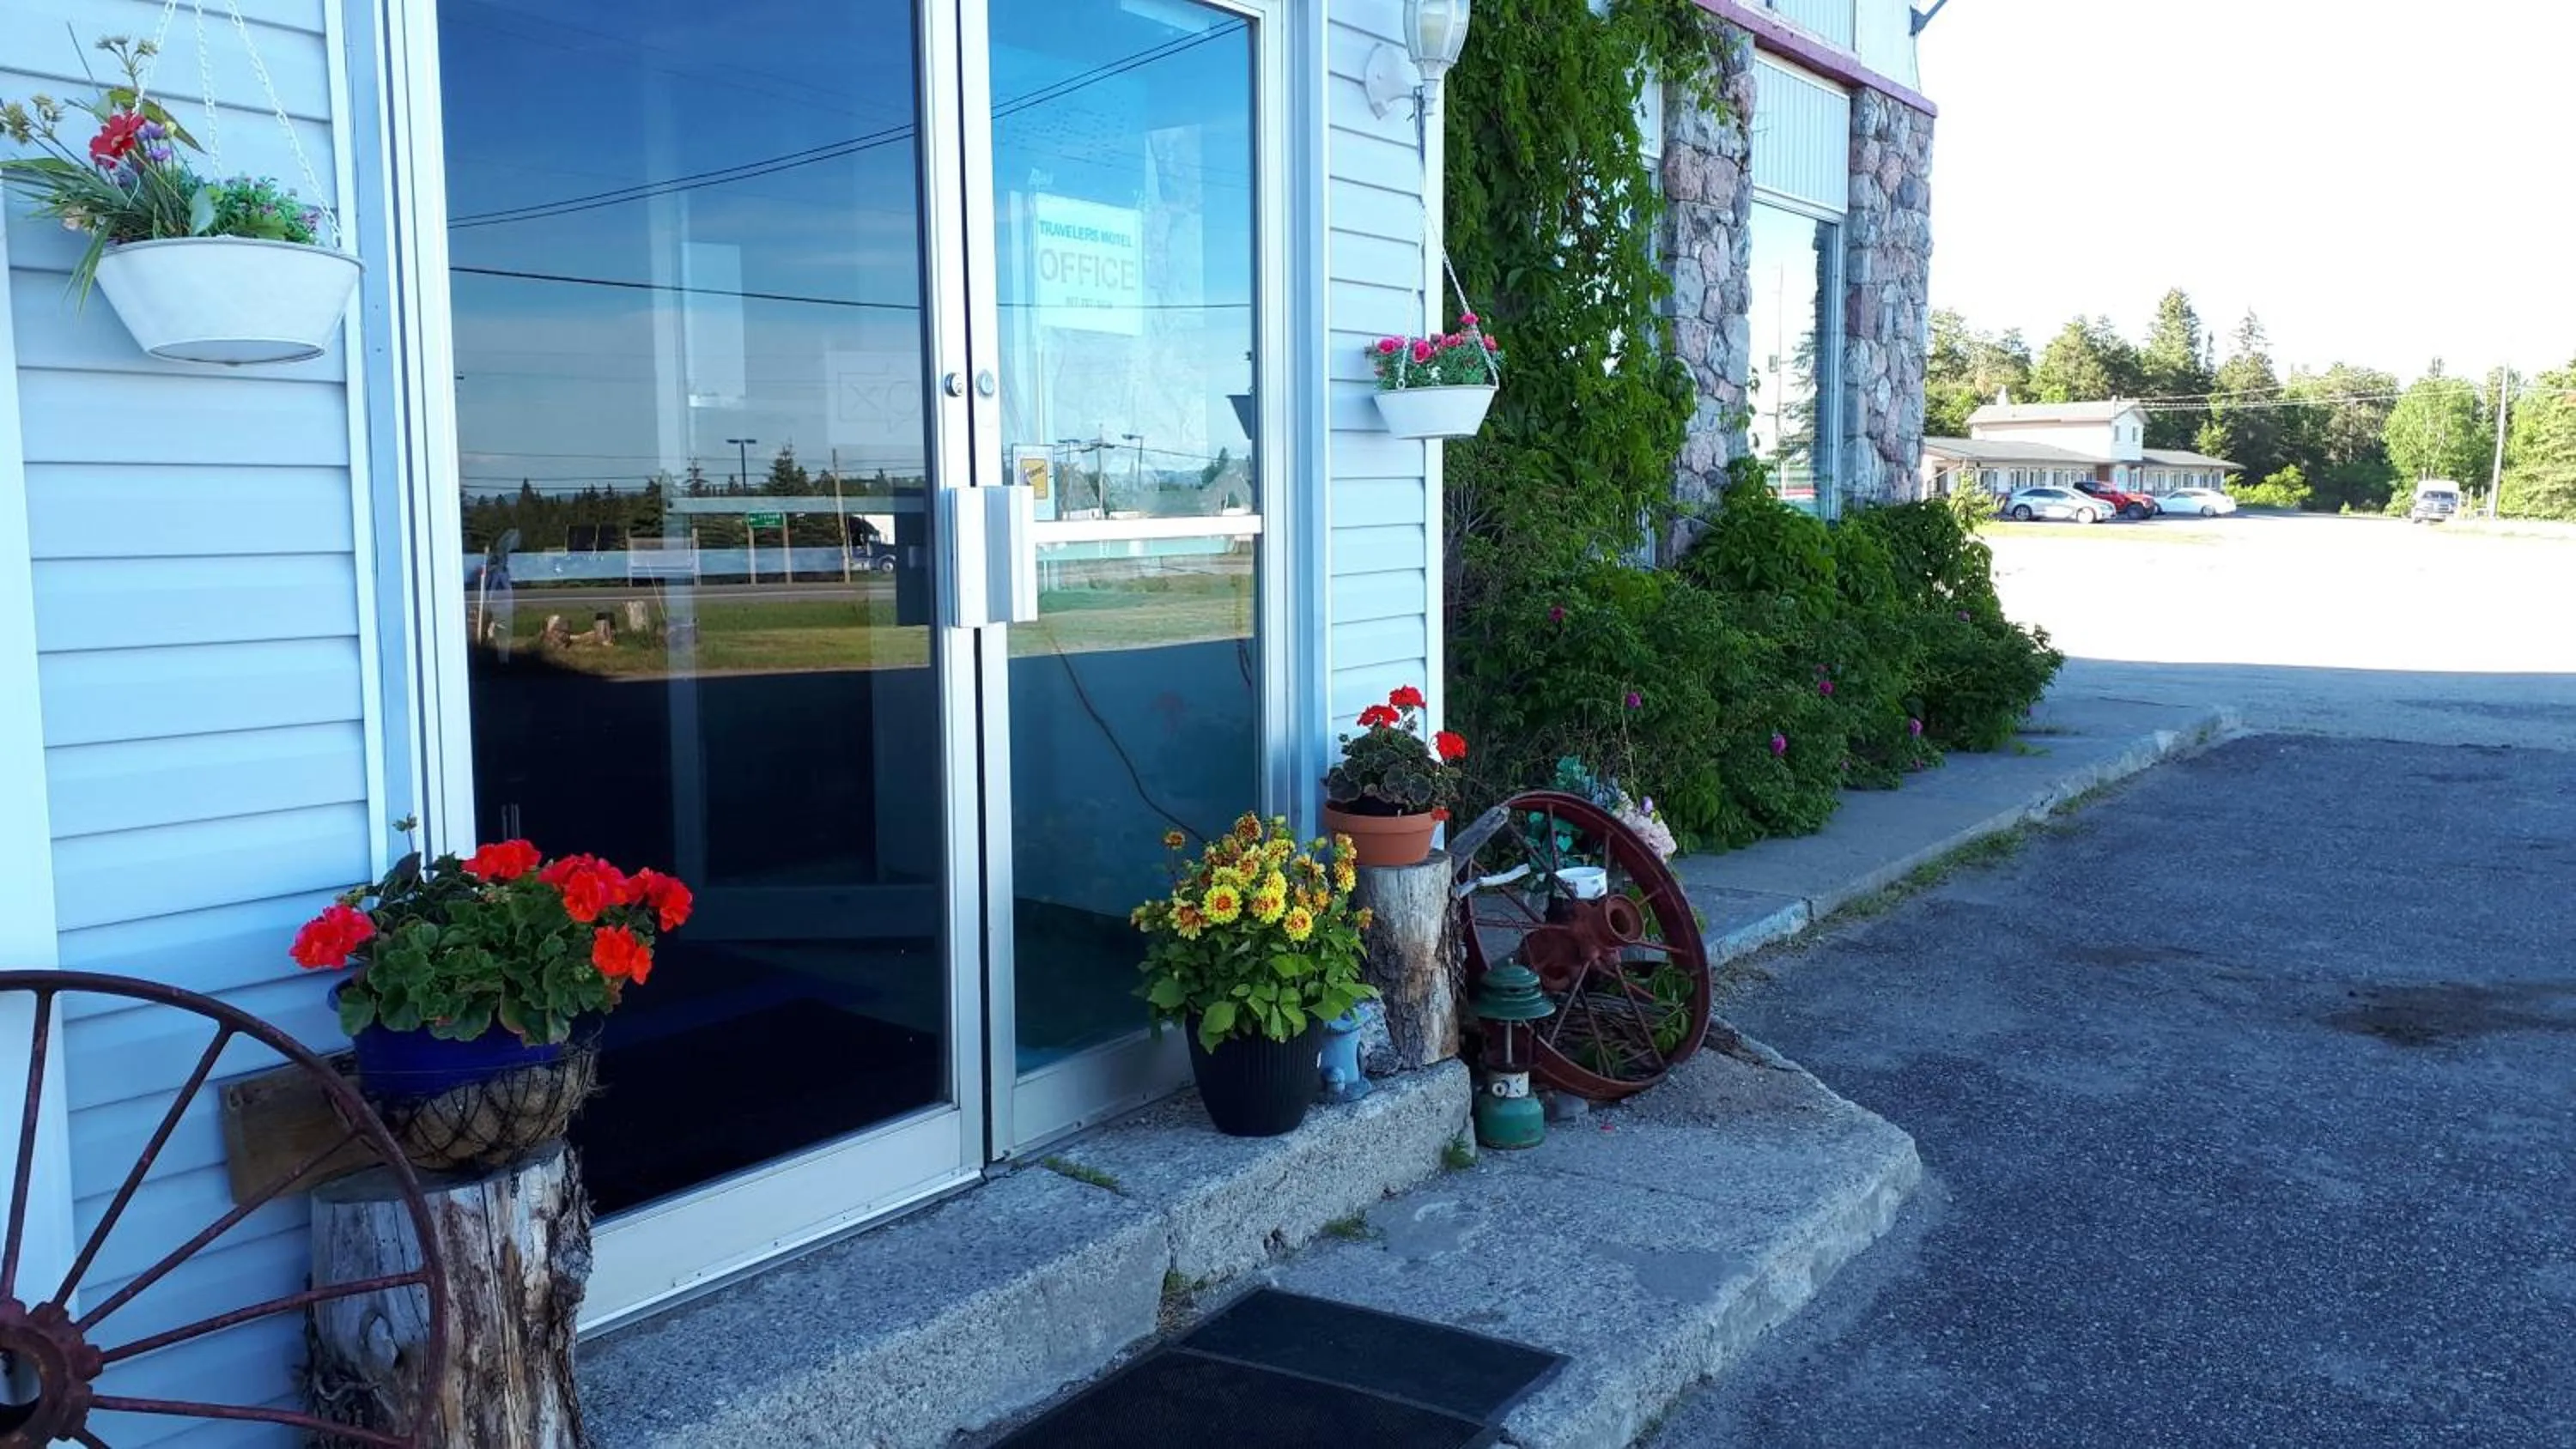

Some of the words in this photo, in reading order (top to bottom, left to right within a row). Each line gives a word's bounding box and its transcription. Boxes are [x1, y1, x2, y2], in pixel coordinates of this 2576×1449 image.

[1039, 221, 1099, 243] TRAVELERS
[1101, 230, 1132, 247] MOTEL
[1040, 249, 1134, 290] OFFICE
